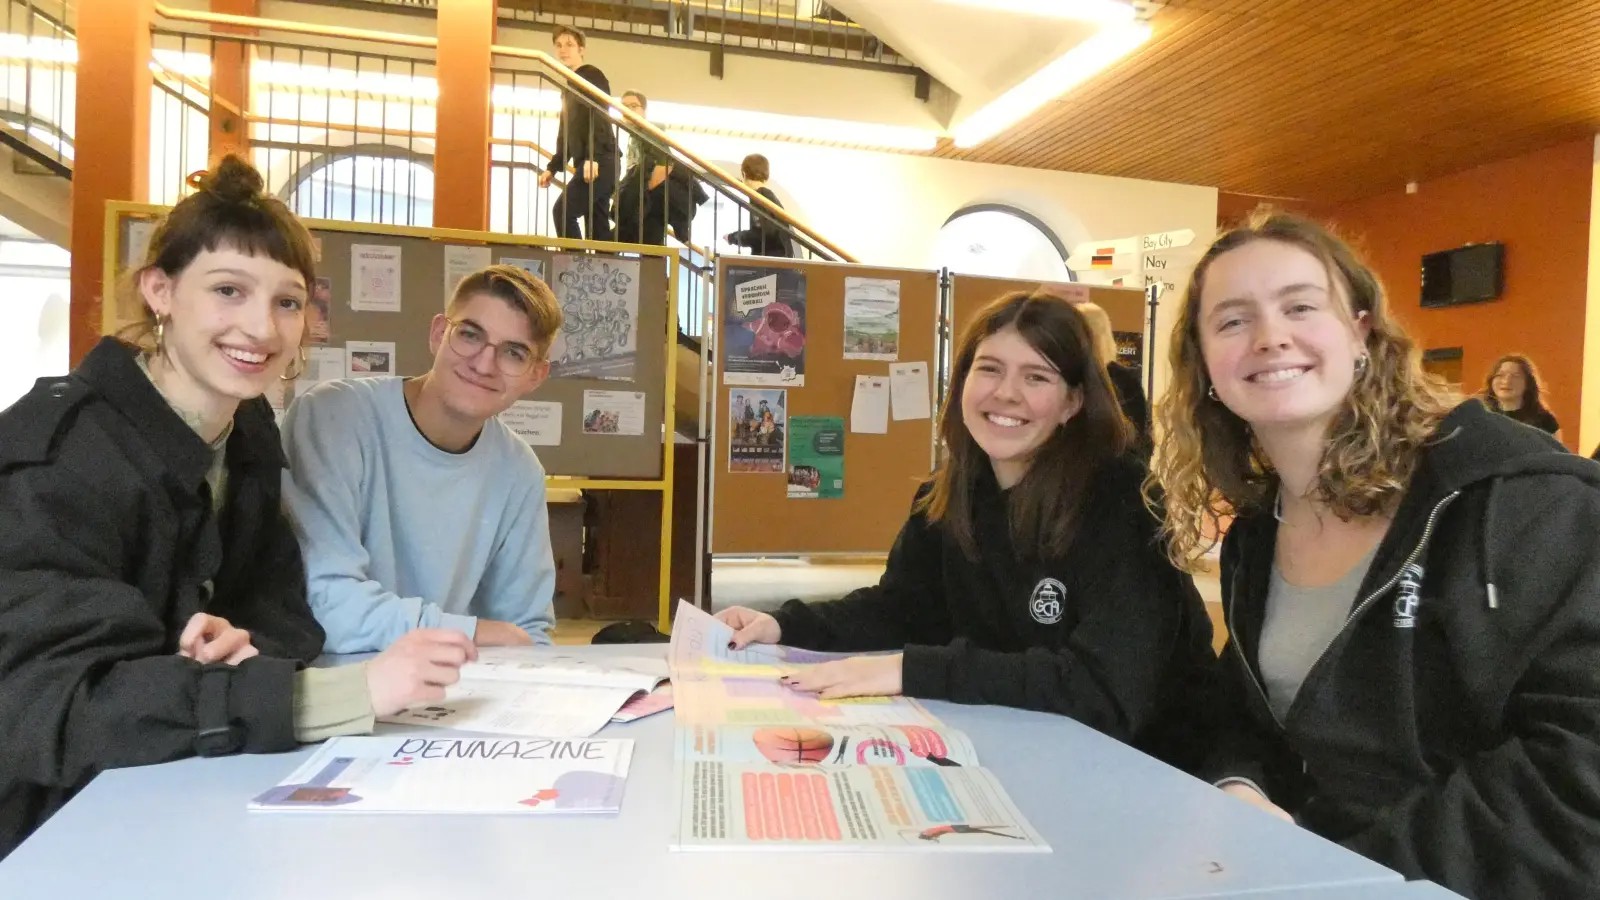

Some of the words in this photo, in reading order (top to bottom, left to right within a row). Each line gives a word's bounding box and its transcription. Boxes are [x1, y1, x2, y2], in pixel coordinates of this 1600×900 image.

[1143, 236, 1158, 250] Bay
[1158, 233, 1173, 248] City
[1145, 255, 1167, 269] Nay
[392, 738, 607, 760] PENNAZINE
